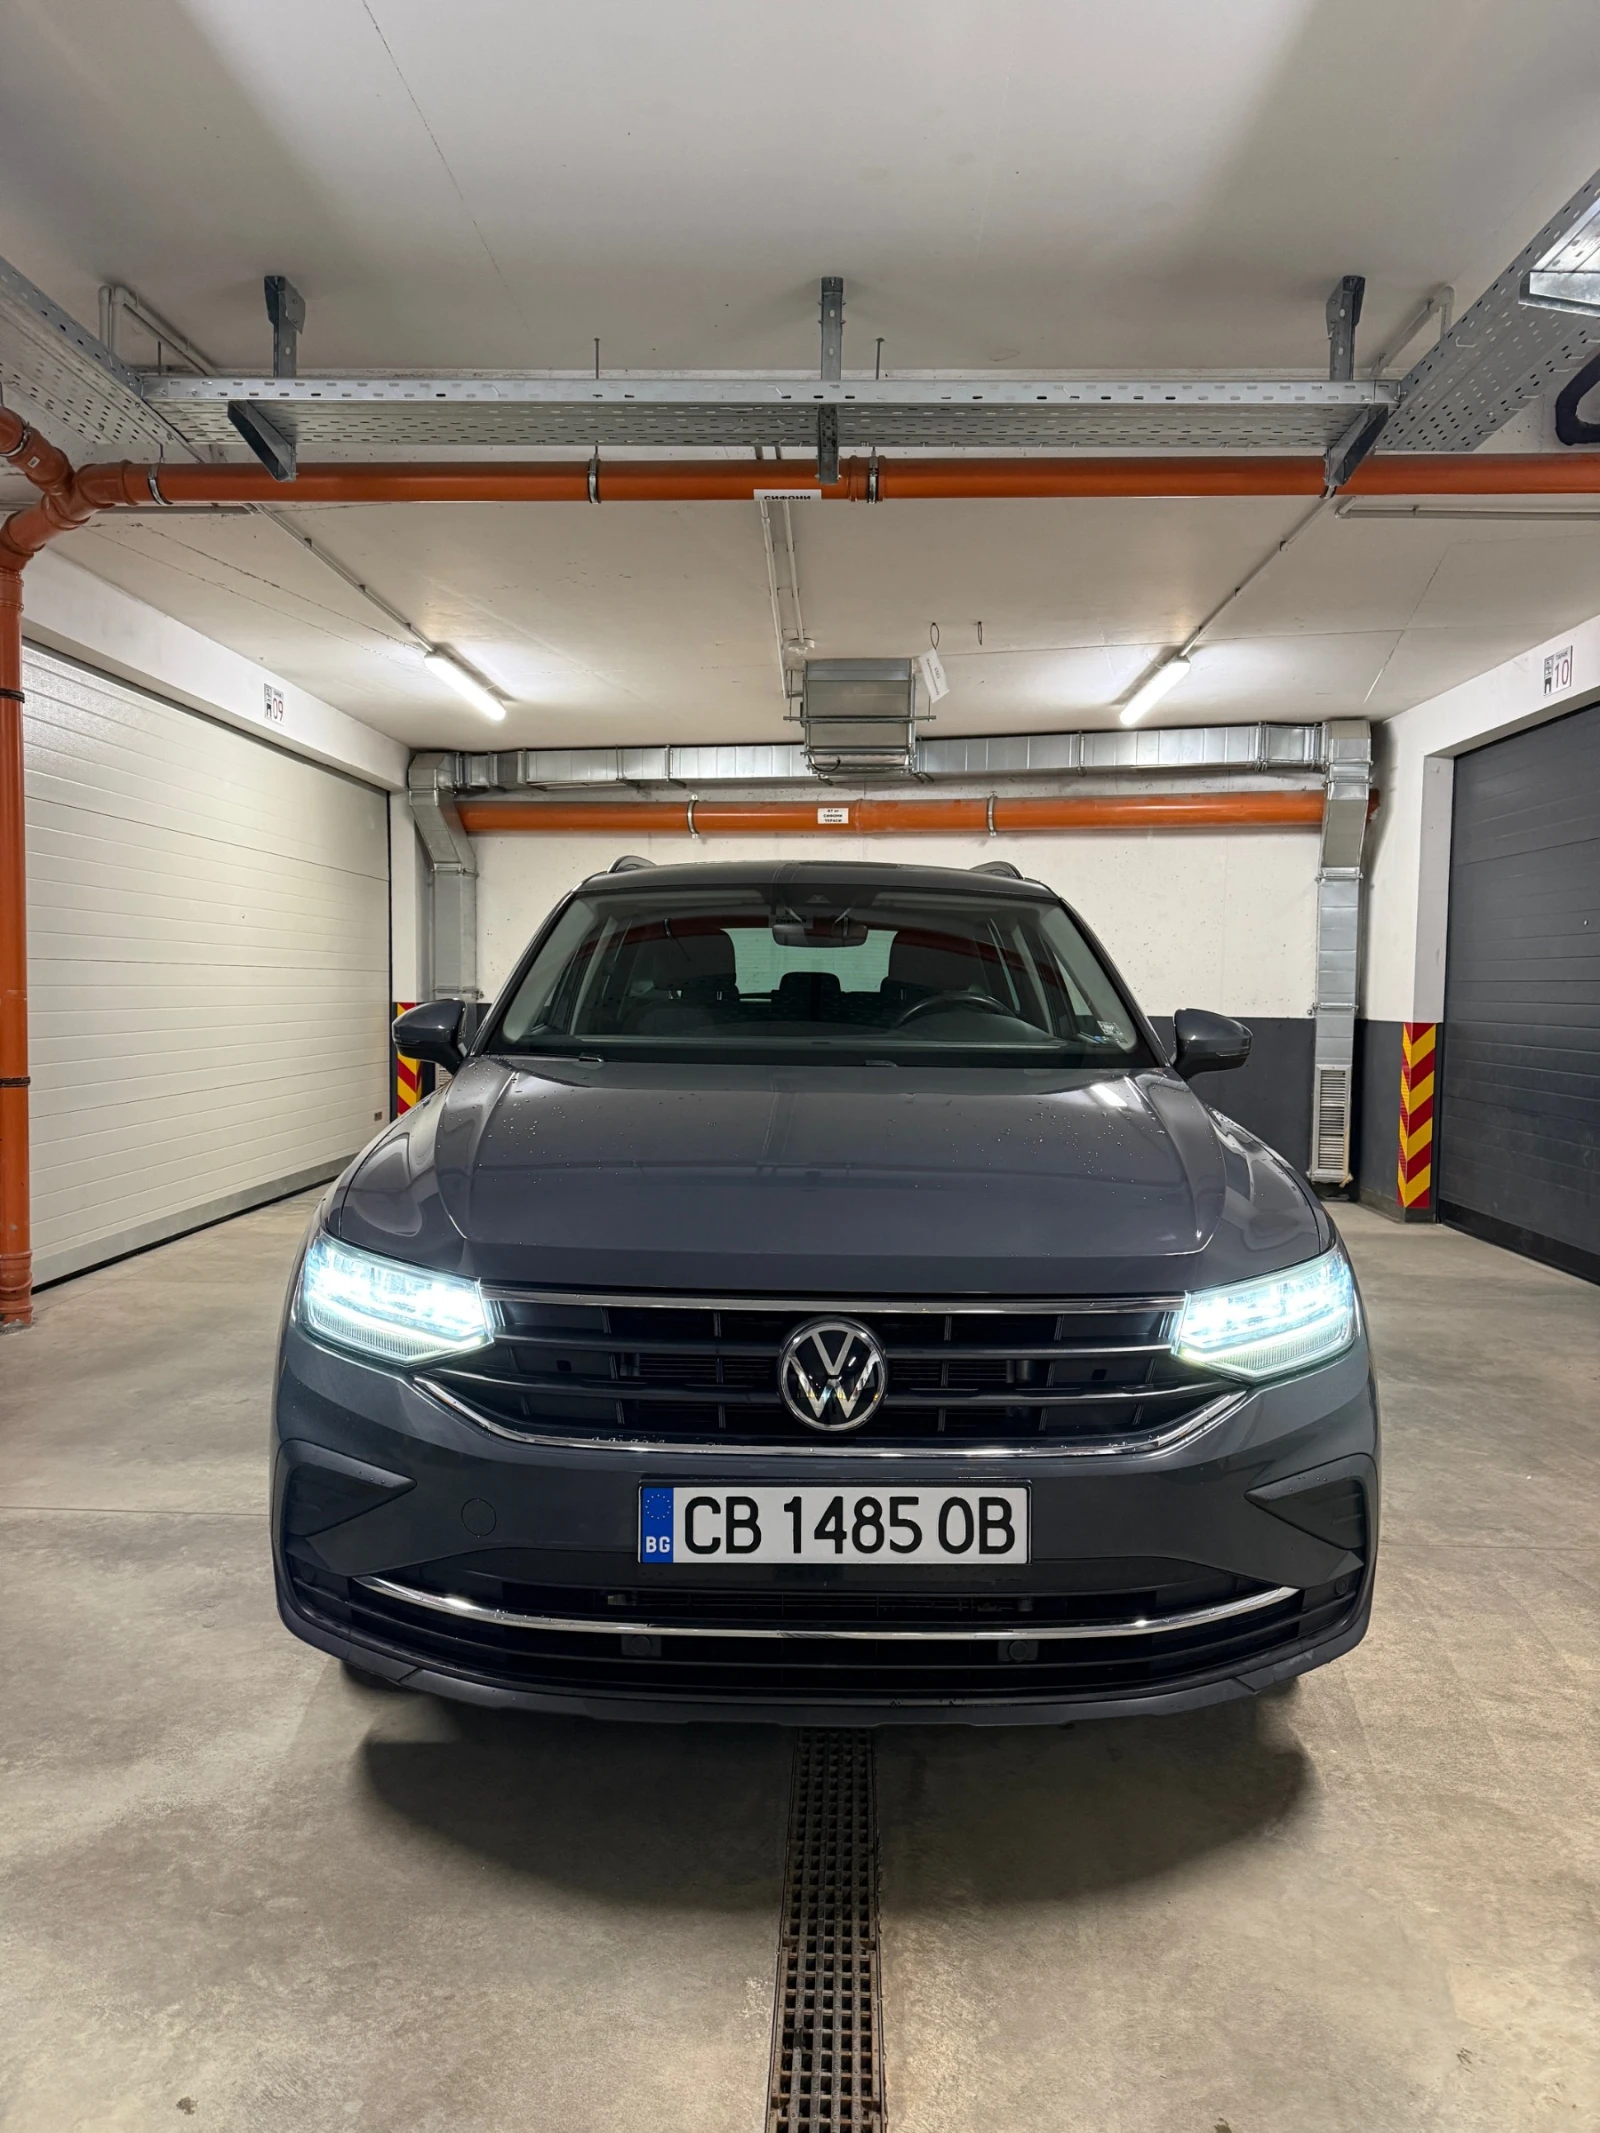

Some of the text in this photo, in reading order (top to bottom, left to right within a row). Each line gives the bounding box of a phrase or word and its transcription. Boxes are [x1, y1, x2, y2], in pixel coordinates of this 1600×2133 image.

[1555, 659, 1570, 688] 10
[273, 697, 284, 722] 09
[684, 1496, 762, 1554] CB
[783, 1496, 922, 1554] 1485
[645, 1535, 671, 1553] BG
